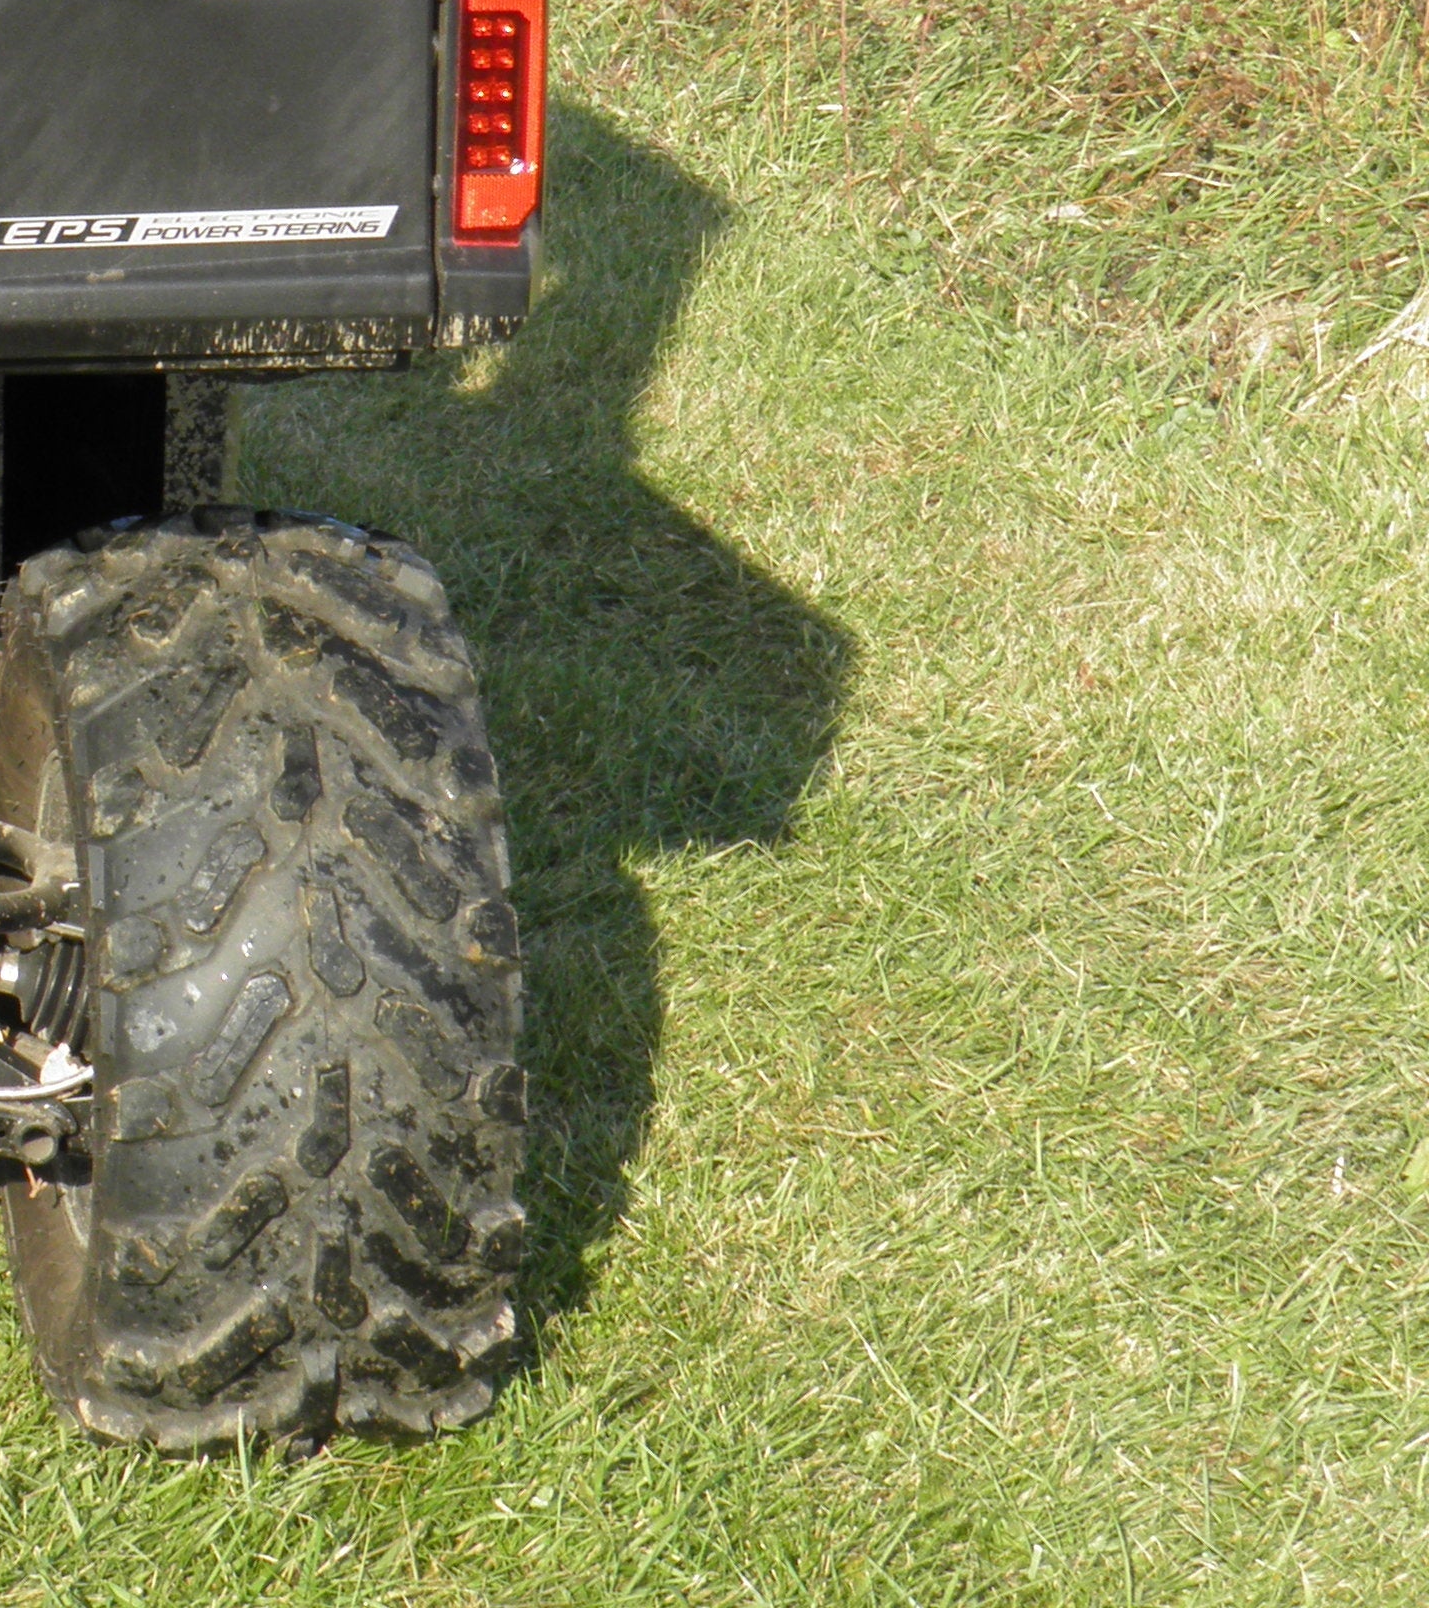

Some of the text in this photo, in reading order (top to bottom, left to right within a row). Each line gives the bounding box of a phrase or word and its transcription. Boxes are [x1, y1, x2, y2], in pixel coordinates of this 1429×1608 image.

[151, 209, 379, 225] ELECTRONIC
[3, 218, 127, 245] EPS
[141, 220, 380, 240] POWER STEERING
